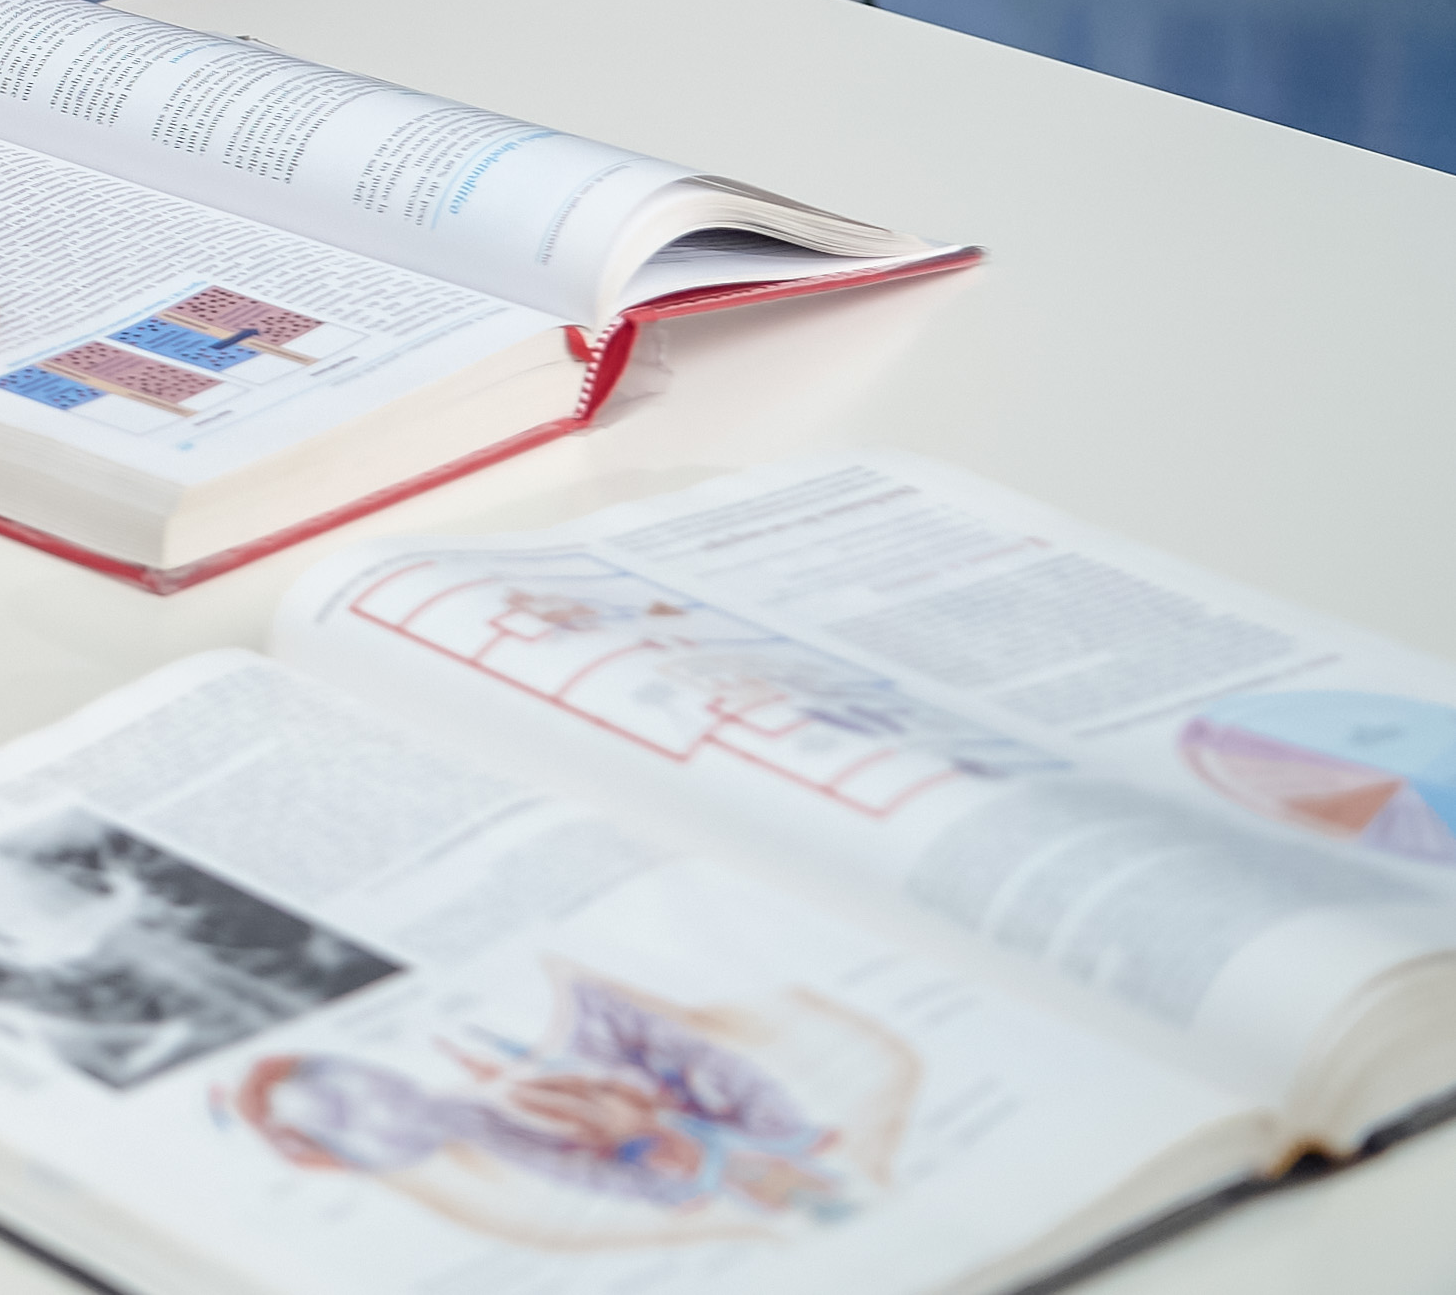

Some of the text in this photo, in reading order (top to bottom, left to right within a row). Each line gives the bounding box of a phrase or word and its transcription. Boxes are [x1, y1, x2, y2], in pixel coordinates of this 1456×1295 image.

[5, 55, 24, 74] due
[8, 52, 38, 98] maggiore
[20, 80, 36, 101] una
[48, 66, 74, 109] membra-
[59, 73, 83, 114] riportati
[71, 76, 95, 116] maggior
[83, 60, 123, 121] extracellulare
[95, 90, 116, 125] Poiché
[107, 92, 128, 127] fisiolo-
[163, 93, 192, 138] elettroliti
[149, 113, 166, 142] strut-
[172, 122, 190, 150] della
[184, 130, 201, 154] tutti
[222, 103, 260, 158] rappresenta
[245, 145, 262, 173] delle
[272, 148, 289, 172] tutti
[283, 117, 327, 185] intracellulare
[363, 174, 381, 210] questo
[381, 152, 413, 201] soddisfare
[424, 180, 440, 198] del
[414, 199, 430, 227] peso
